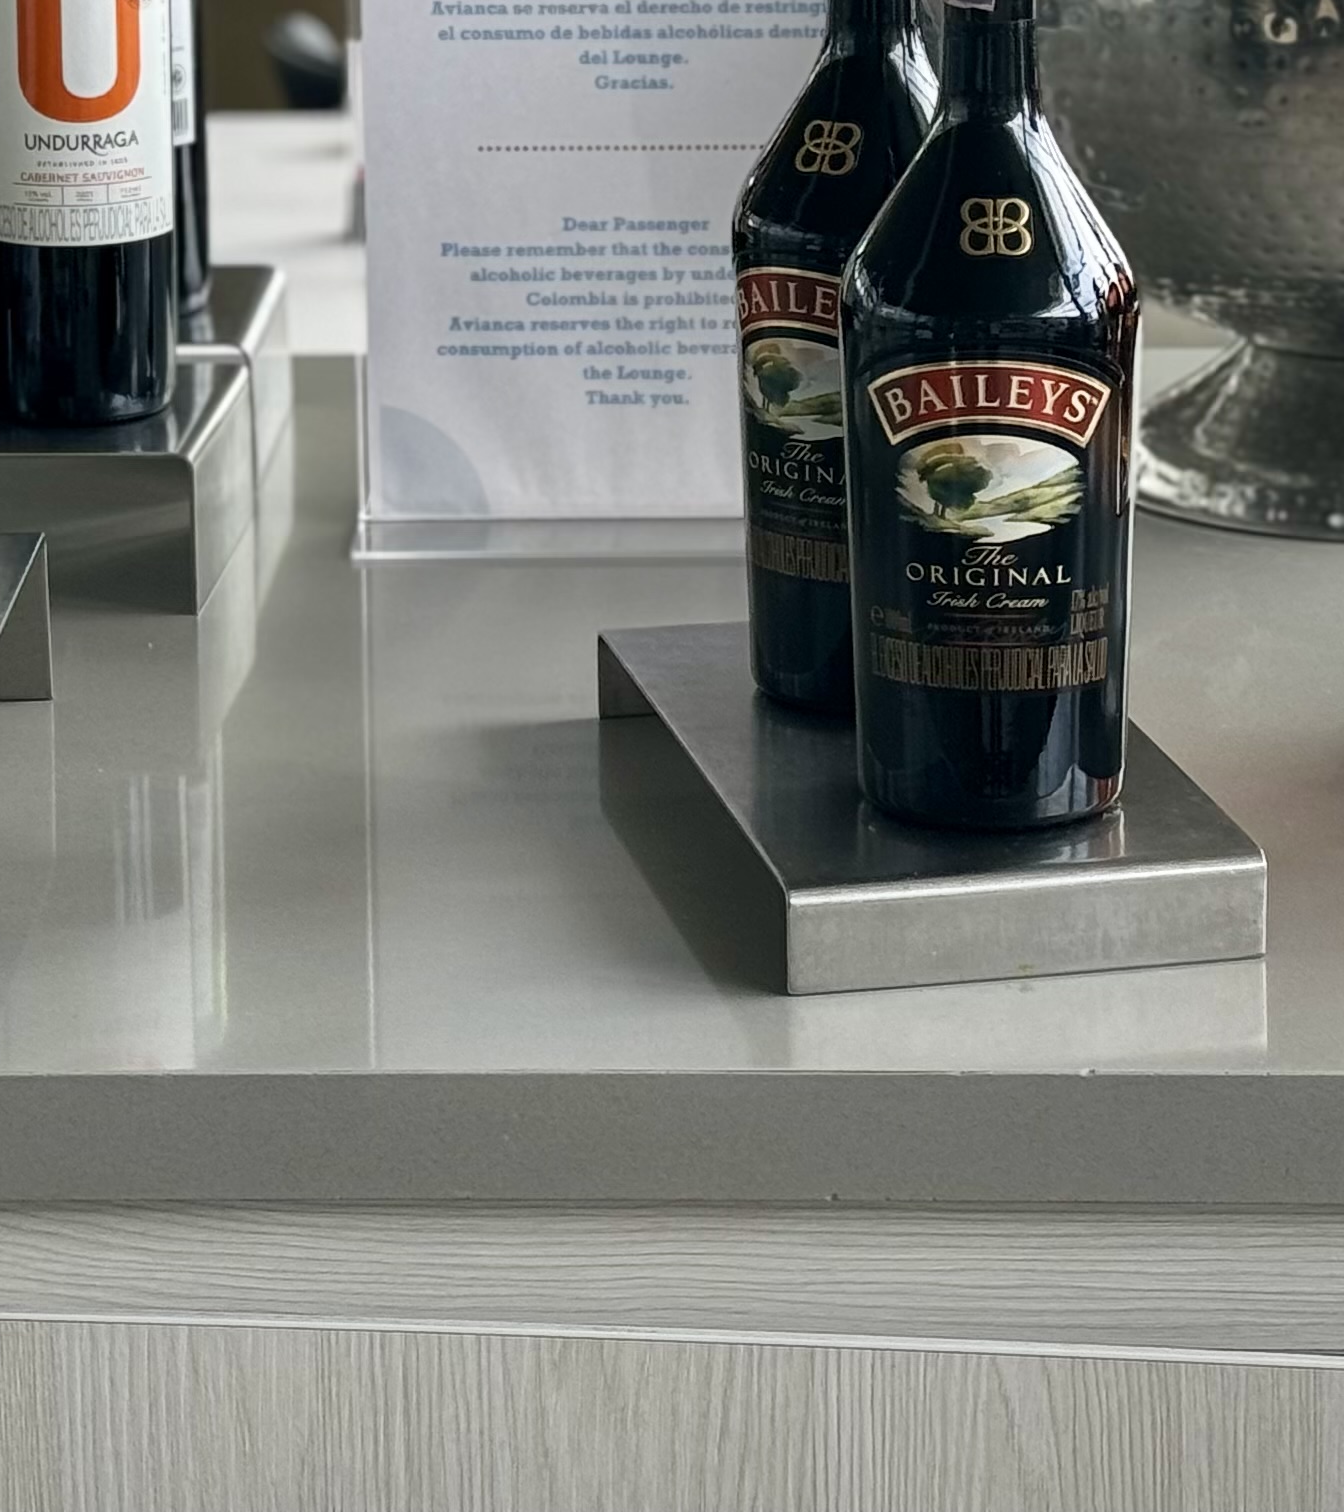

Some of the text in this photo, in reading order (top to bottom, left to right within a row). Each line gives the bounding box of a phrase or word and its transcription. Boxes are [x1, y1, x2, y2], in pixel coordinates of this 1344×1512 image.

[430, 0, 510, 16] Avianca
[512, 3, 534, 16] se
[537, 3, 610, 16] reserva
[614, 0, 633, 15] el
[716, 0, 742, 15] de
[744, 0, 828, 18] restringi
[437, 25, 456, 42] el
[459, 28, 546, 41] consumo
[549, 25, 574, 41] de
[577, 24, 653, 40] bebidas
[656, 23, 765, 40] alcohólicas
[578, 49, 690, 68] del Lounge.
[593, 74, 676, 91] Gracias.
[24, 130, 139, 156] UNDURRAGA
[20, 166, 145, 183] CABERNET SAUVIGNON
[561, 216, 711, 235] Dear Passenger
[439, 241, 503, 258] Please
[505, 241, 607, 258] remember
[611, 241, 648, 257] that
[652, 241, 683, 257] the
[469, 266, 736, 286] alcoholic beverages by unde
[525, 291, 618, 307] Colombia
[622, 291, 640, 306] is
[737, 279, 837, 321] BAILE
[448, 316, 526, 333] Avianca
[529, 319, 611, 332] reserves
[614, 315, 645, 331] the
[648, 315, 695, 335] right
[700, 316, 718, 331] to
[436, 341, 560, 361] consumption
[563, 341, 584, 357] of
[586, 340, 672, 357] alcoholic
[582, 364, 693, 385] the Lounge.
[584, 389, 690, 409] Thank you.
[884, 373, 1093, 425] BAILEYS
[780, 441, 825, 463] The
[749, 450, 845, 485] ORIGIN
[760, 480, 794, 498] Irish
[961, 545, 1019, 566] The
[906, 562, 1072, 587] ORIGINAL
[927, 591, 1050, 609] Irish Cream
